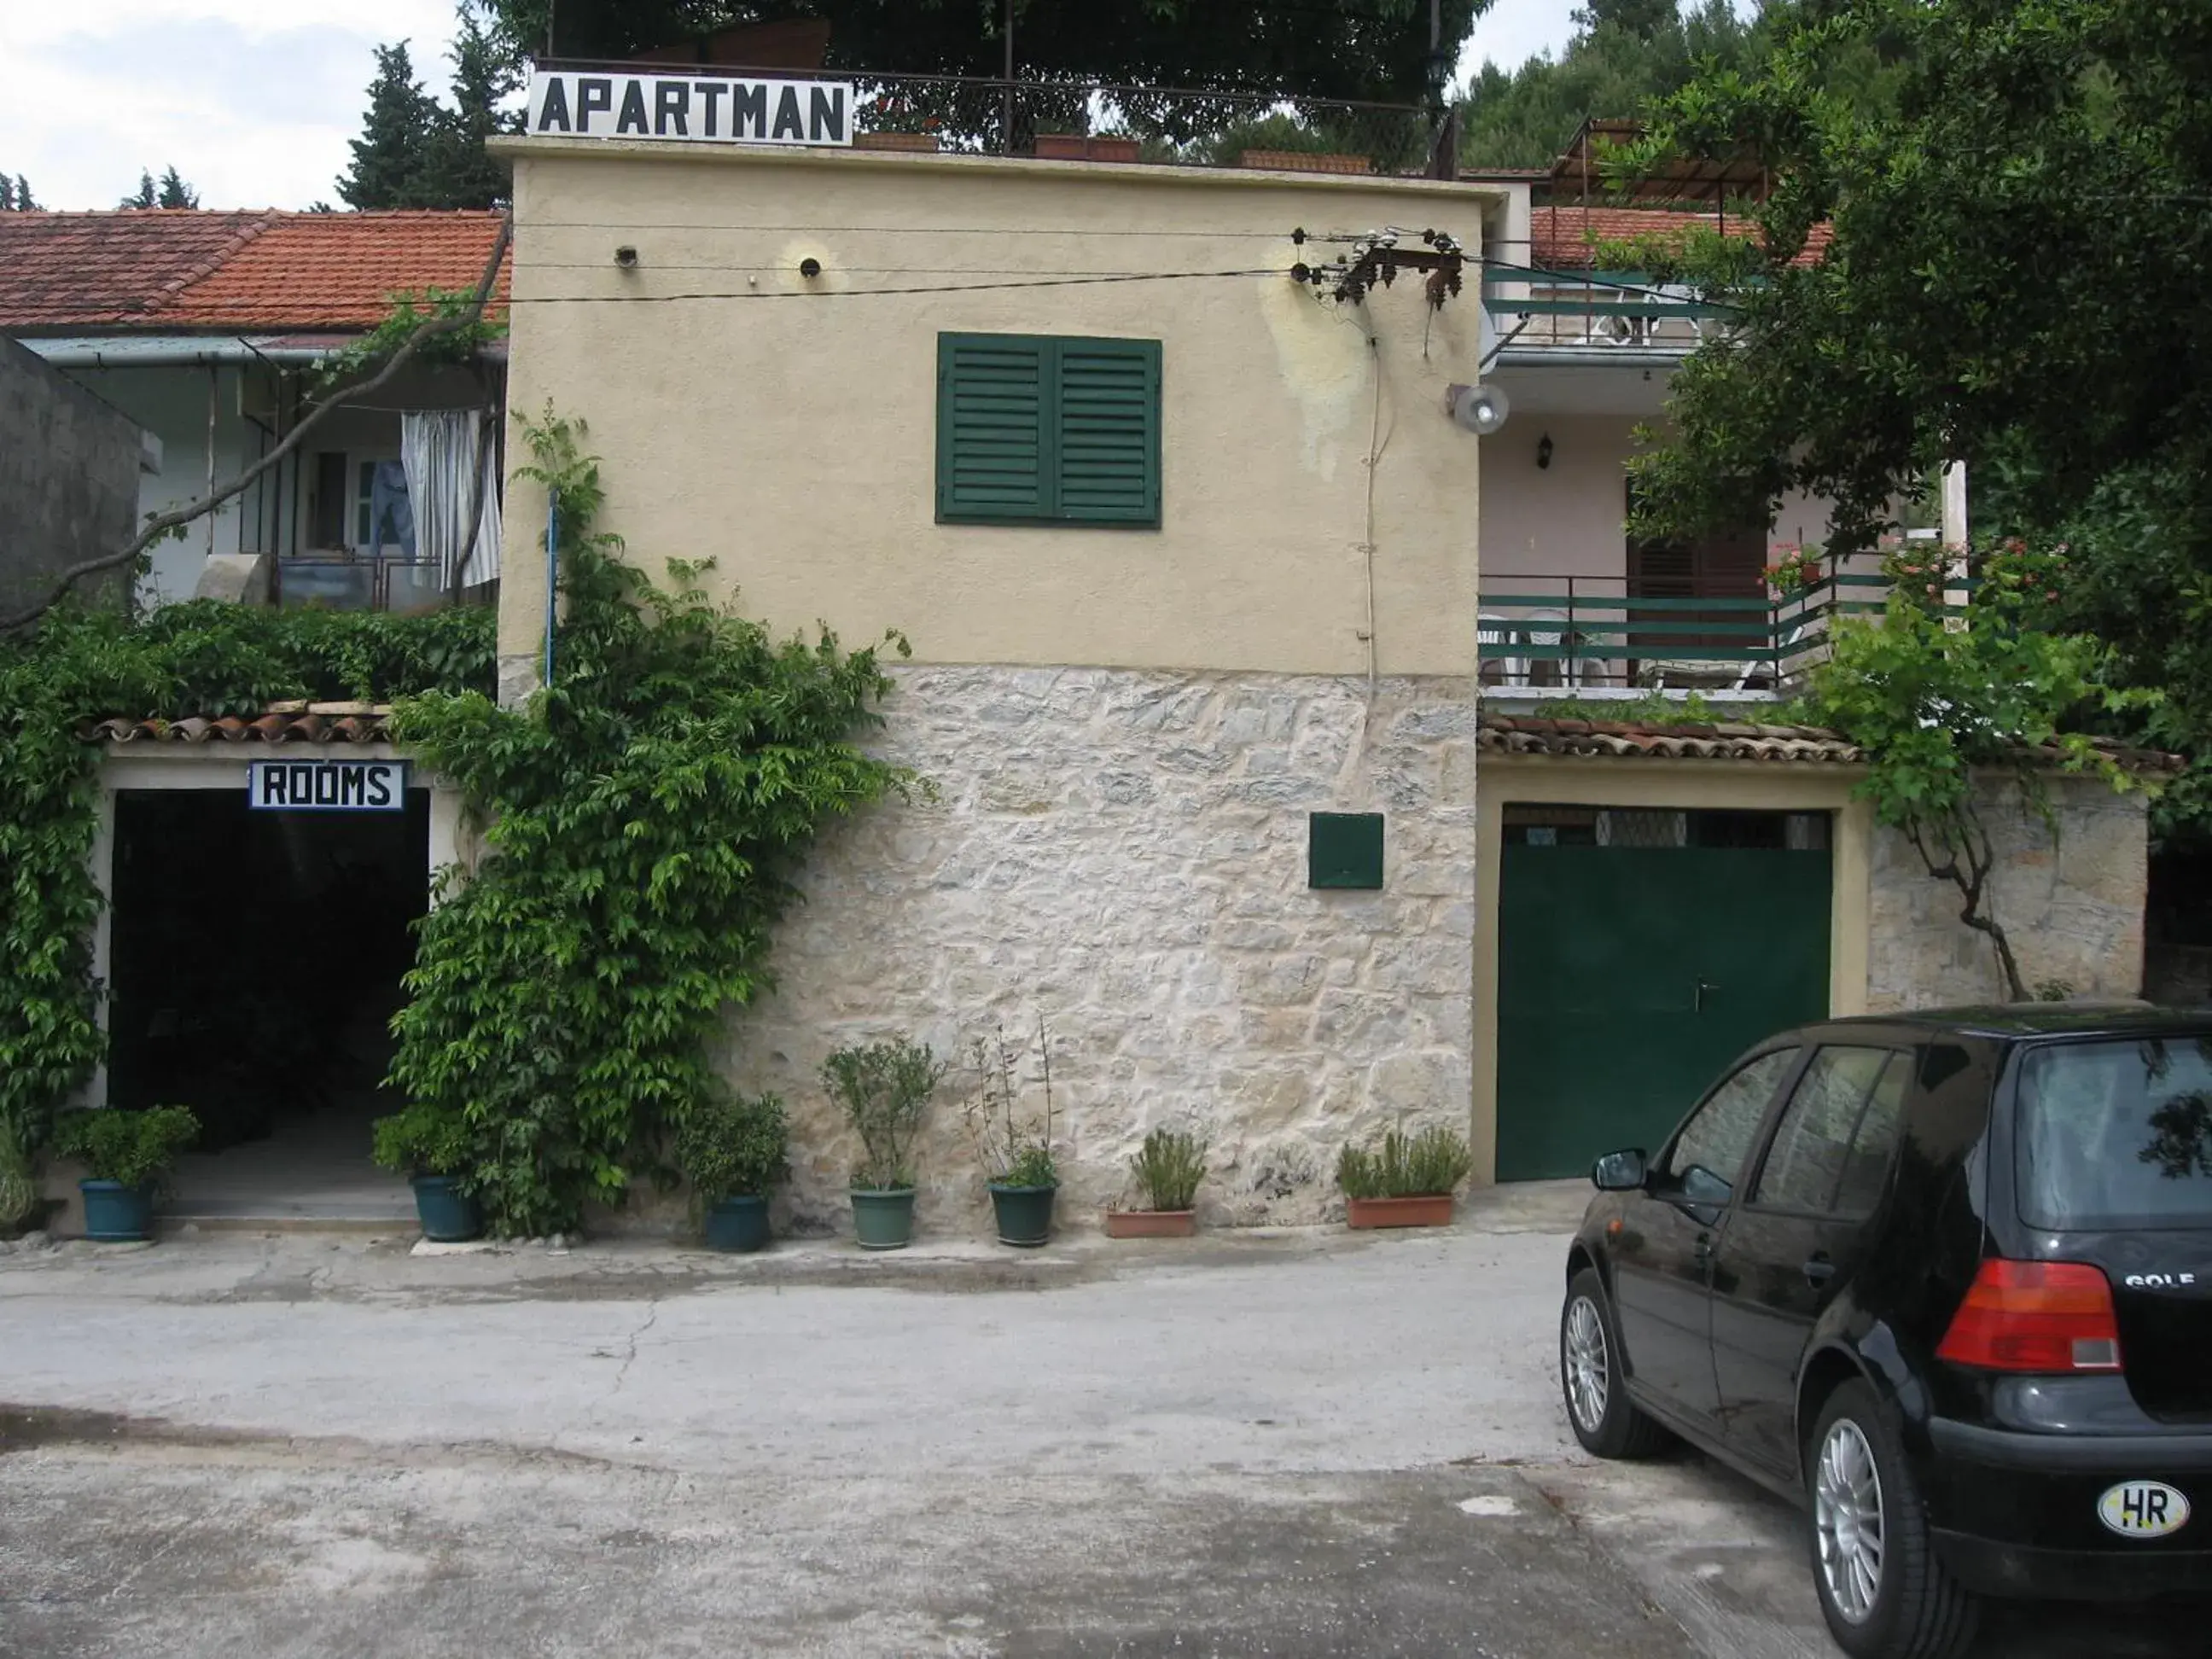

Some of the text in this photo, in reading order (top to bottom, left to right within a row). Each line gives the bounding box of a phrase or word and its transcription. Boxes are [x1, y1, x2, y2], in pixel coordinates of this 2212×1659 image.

[538, 77, 844, 142] APARTMAN
[263, 765, 391, 806] ROOMS
[2125, 1273, 2195, 1289] GOLF
[2122, 1488, 2168, 1528] HR
